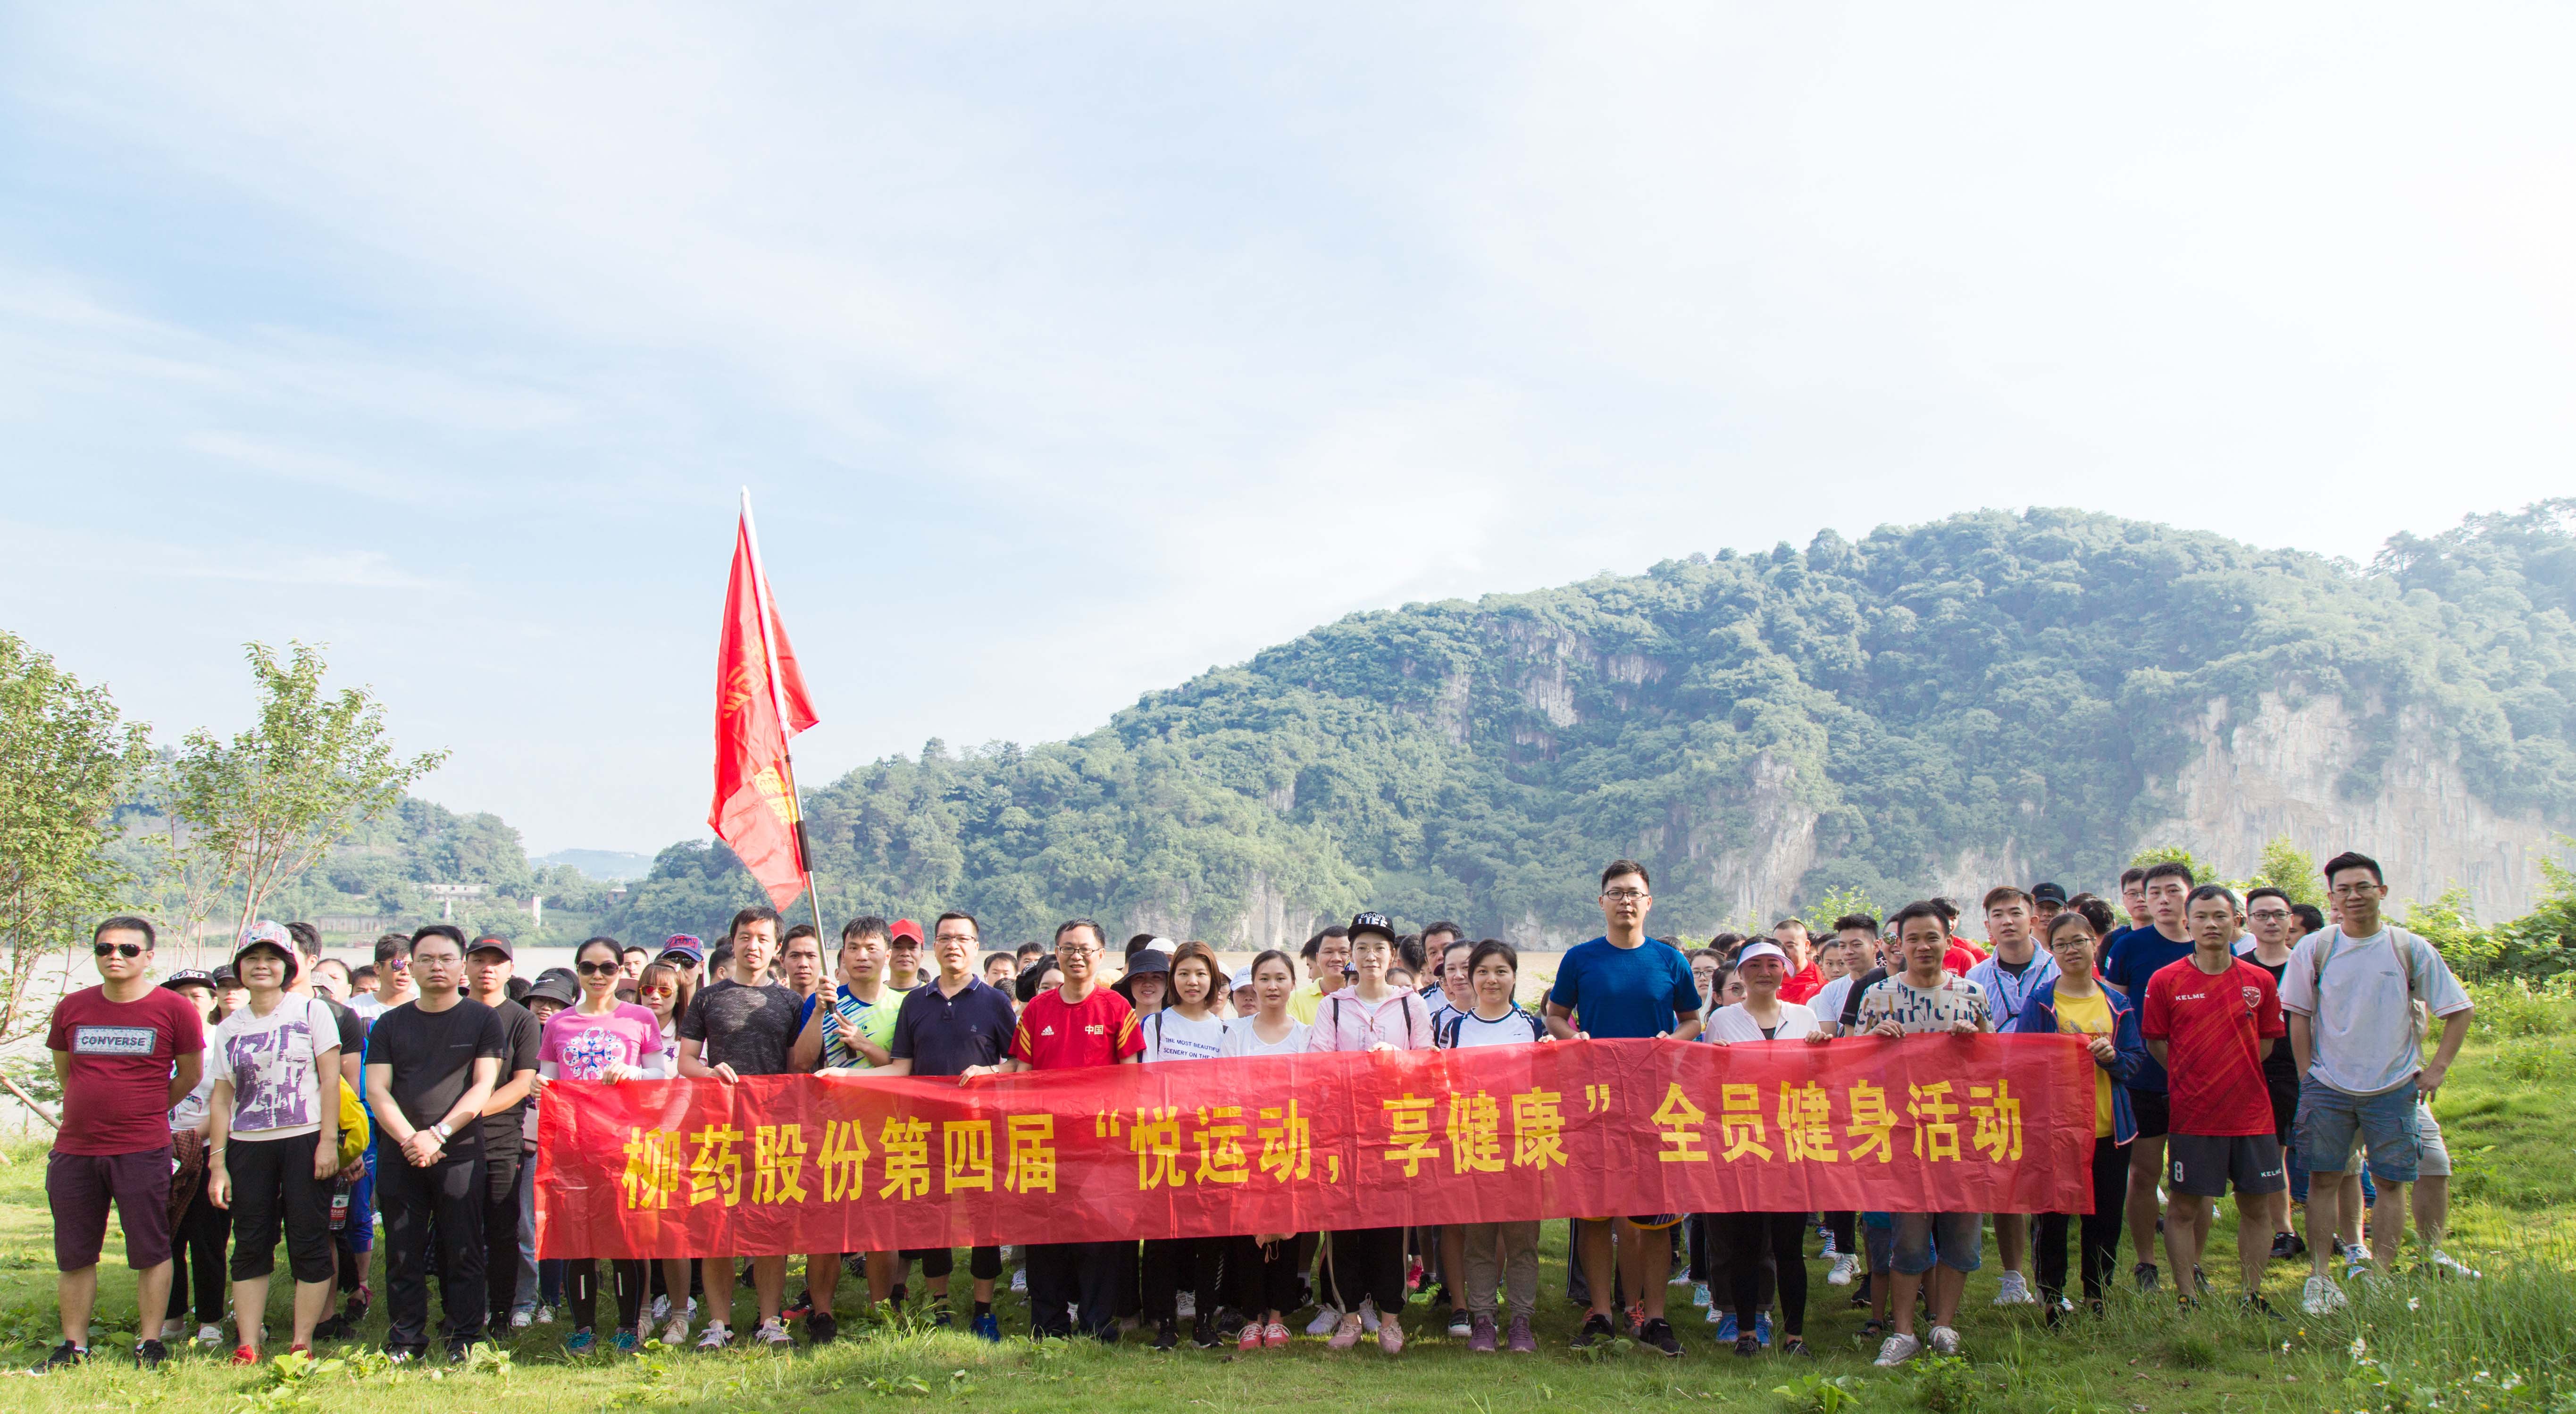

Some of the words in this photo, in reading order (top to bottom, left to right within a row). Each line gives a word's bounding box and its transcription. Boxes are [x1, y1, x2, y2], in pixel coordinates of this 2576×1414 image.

[1361, 913, 1386, 921] EASON'S
[1085, 1025, 1104, 1035] 中国
[82, 1036, 146, 1046] CONVERSE
[1163, 1047, 1188, 1055] SCENERY
[1193, 1042, 1220, 1053] BEAUTIFU
[2174, 1161, 2184, 1182] 8
[2260, 1168, 2282, 1178] KELME
